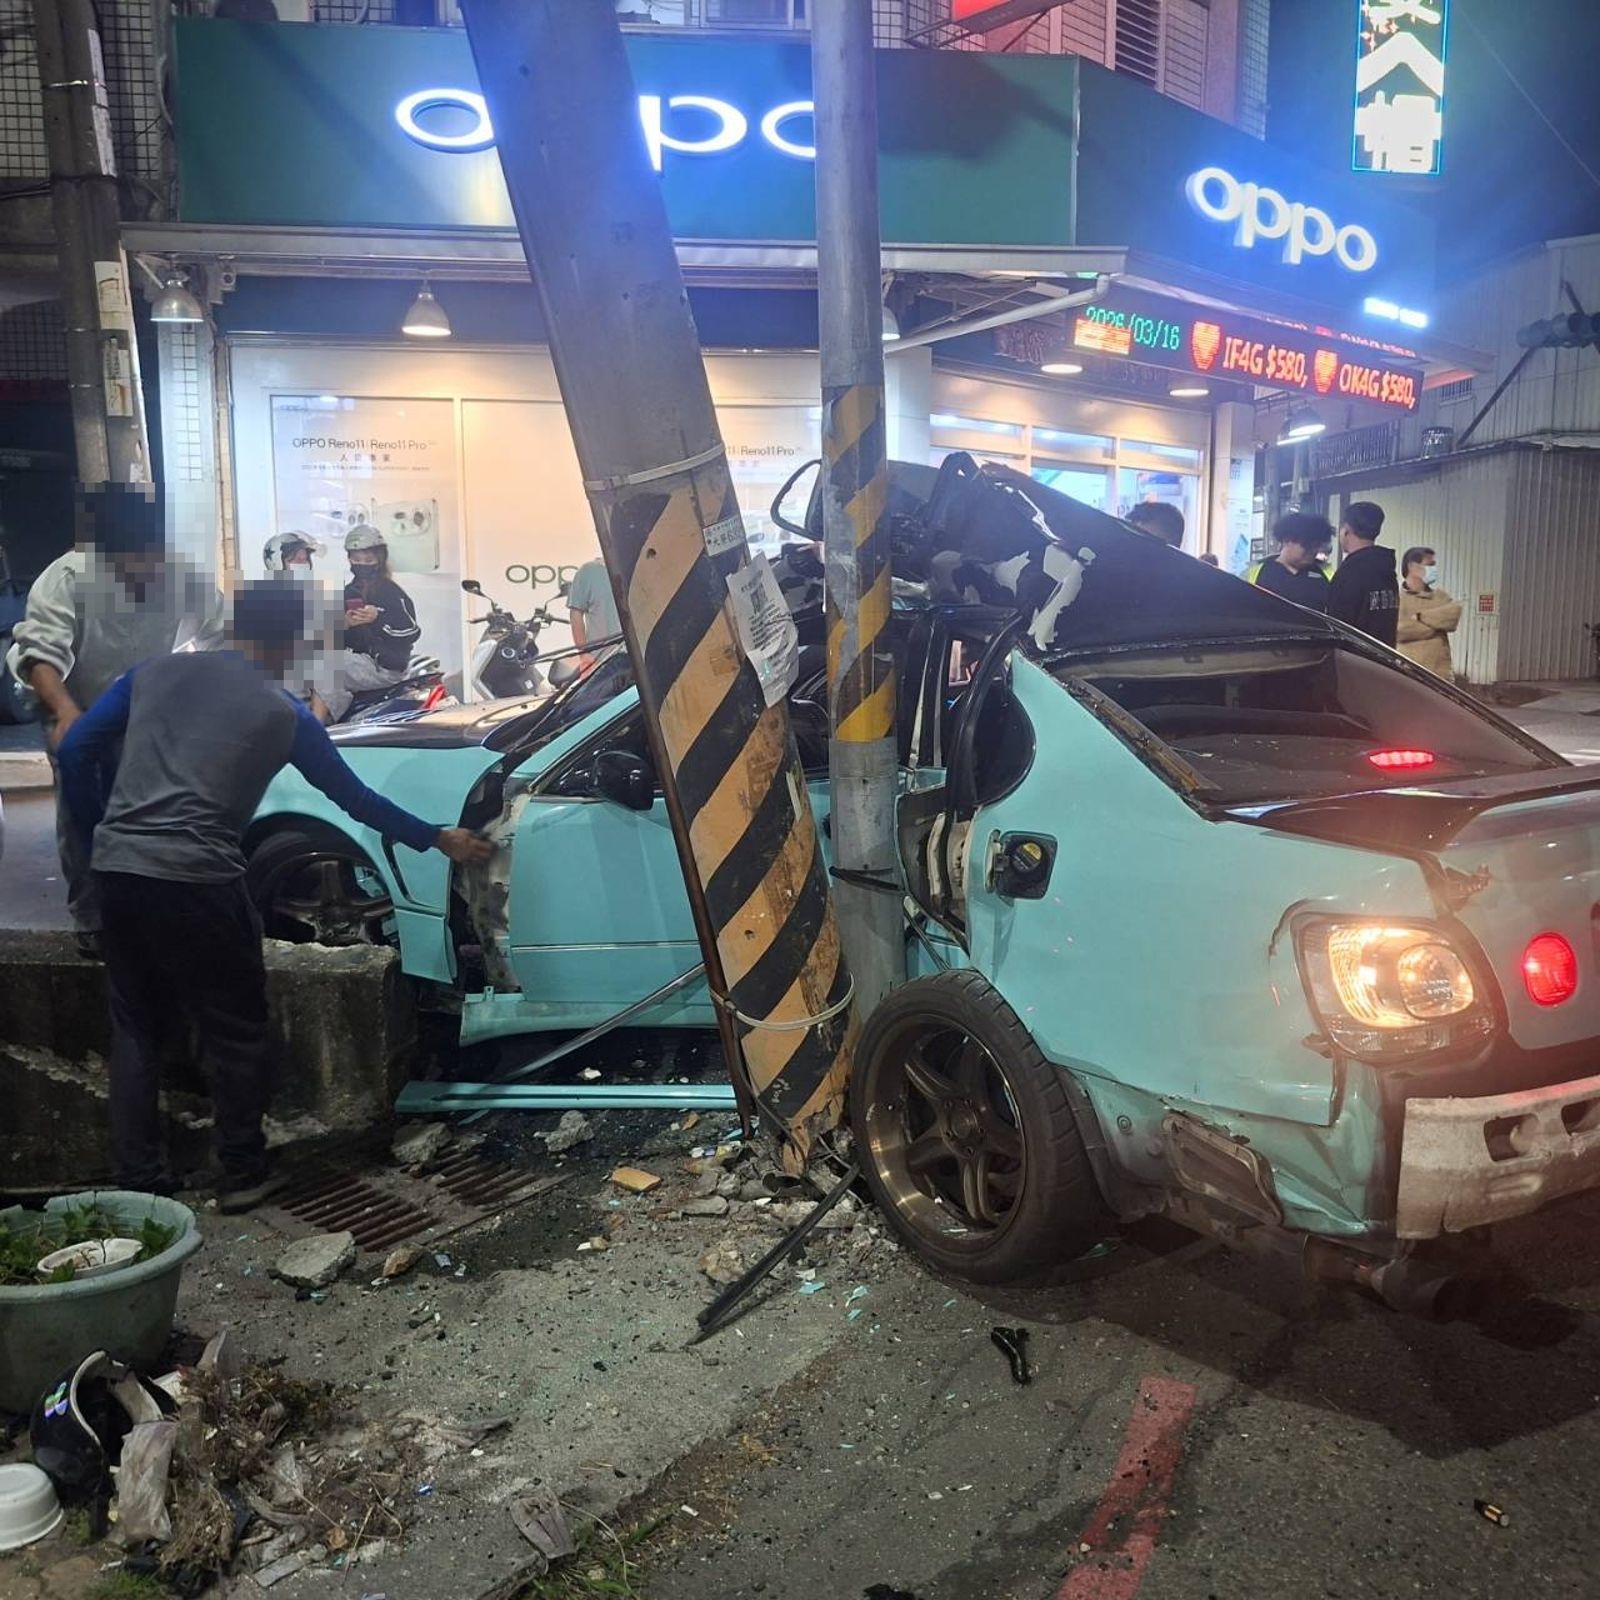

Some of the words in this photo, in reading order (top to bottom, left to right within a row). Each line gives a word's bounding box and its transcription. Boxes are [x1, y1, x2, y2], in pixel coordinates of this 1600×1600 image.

[1187, 166, 1378, 272] oppo
[292, 438, 326, 449] OPPO
[328, 438, 365, 449] Reno11
[371, 439, 406, 450] Reno11
[408, 440, 427, 450] Pro
[740, 446, 775, 456] Reno11
[776, 446, 795, 456] Pro
[505, 564, 579, 590] opp
